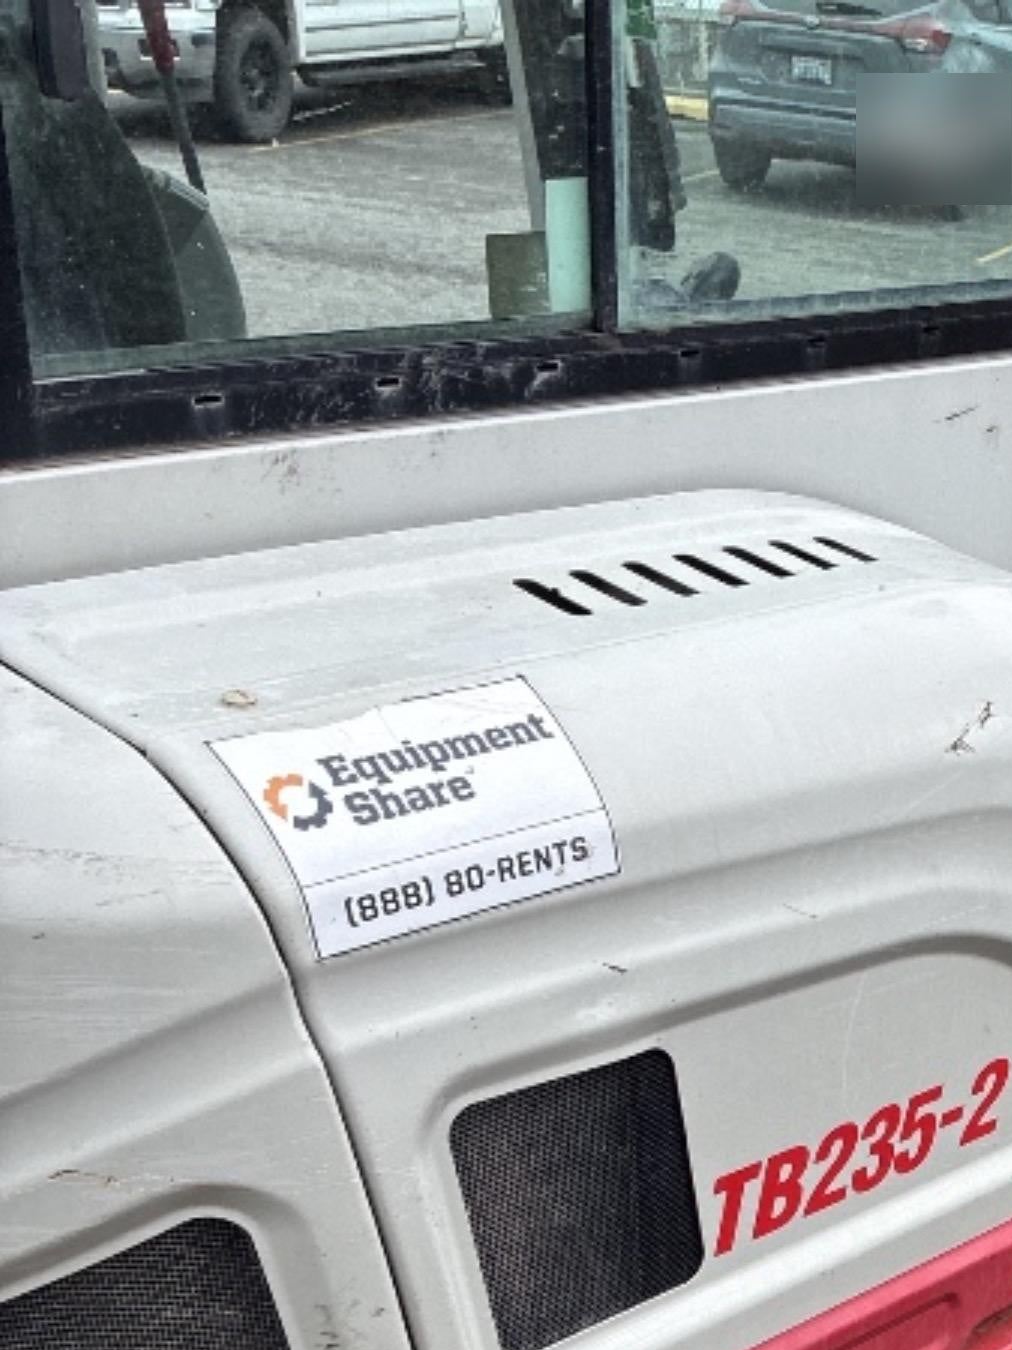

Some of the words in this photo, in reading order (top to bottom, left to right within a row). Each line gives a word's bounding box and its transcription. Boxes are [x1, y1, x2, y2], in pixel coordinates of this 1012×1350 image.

[317, 713, 555, 787] Equipment
[342, 774, 476, 827] Share
[344, 875, 435, 928] (888)
[443, 836, 590, 898] 80-RENTS
[713, 1057, 1010, 1258] TB235-2
